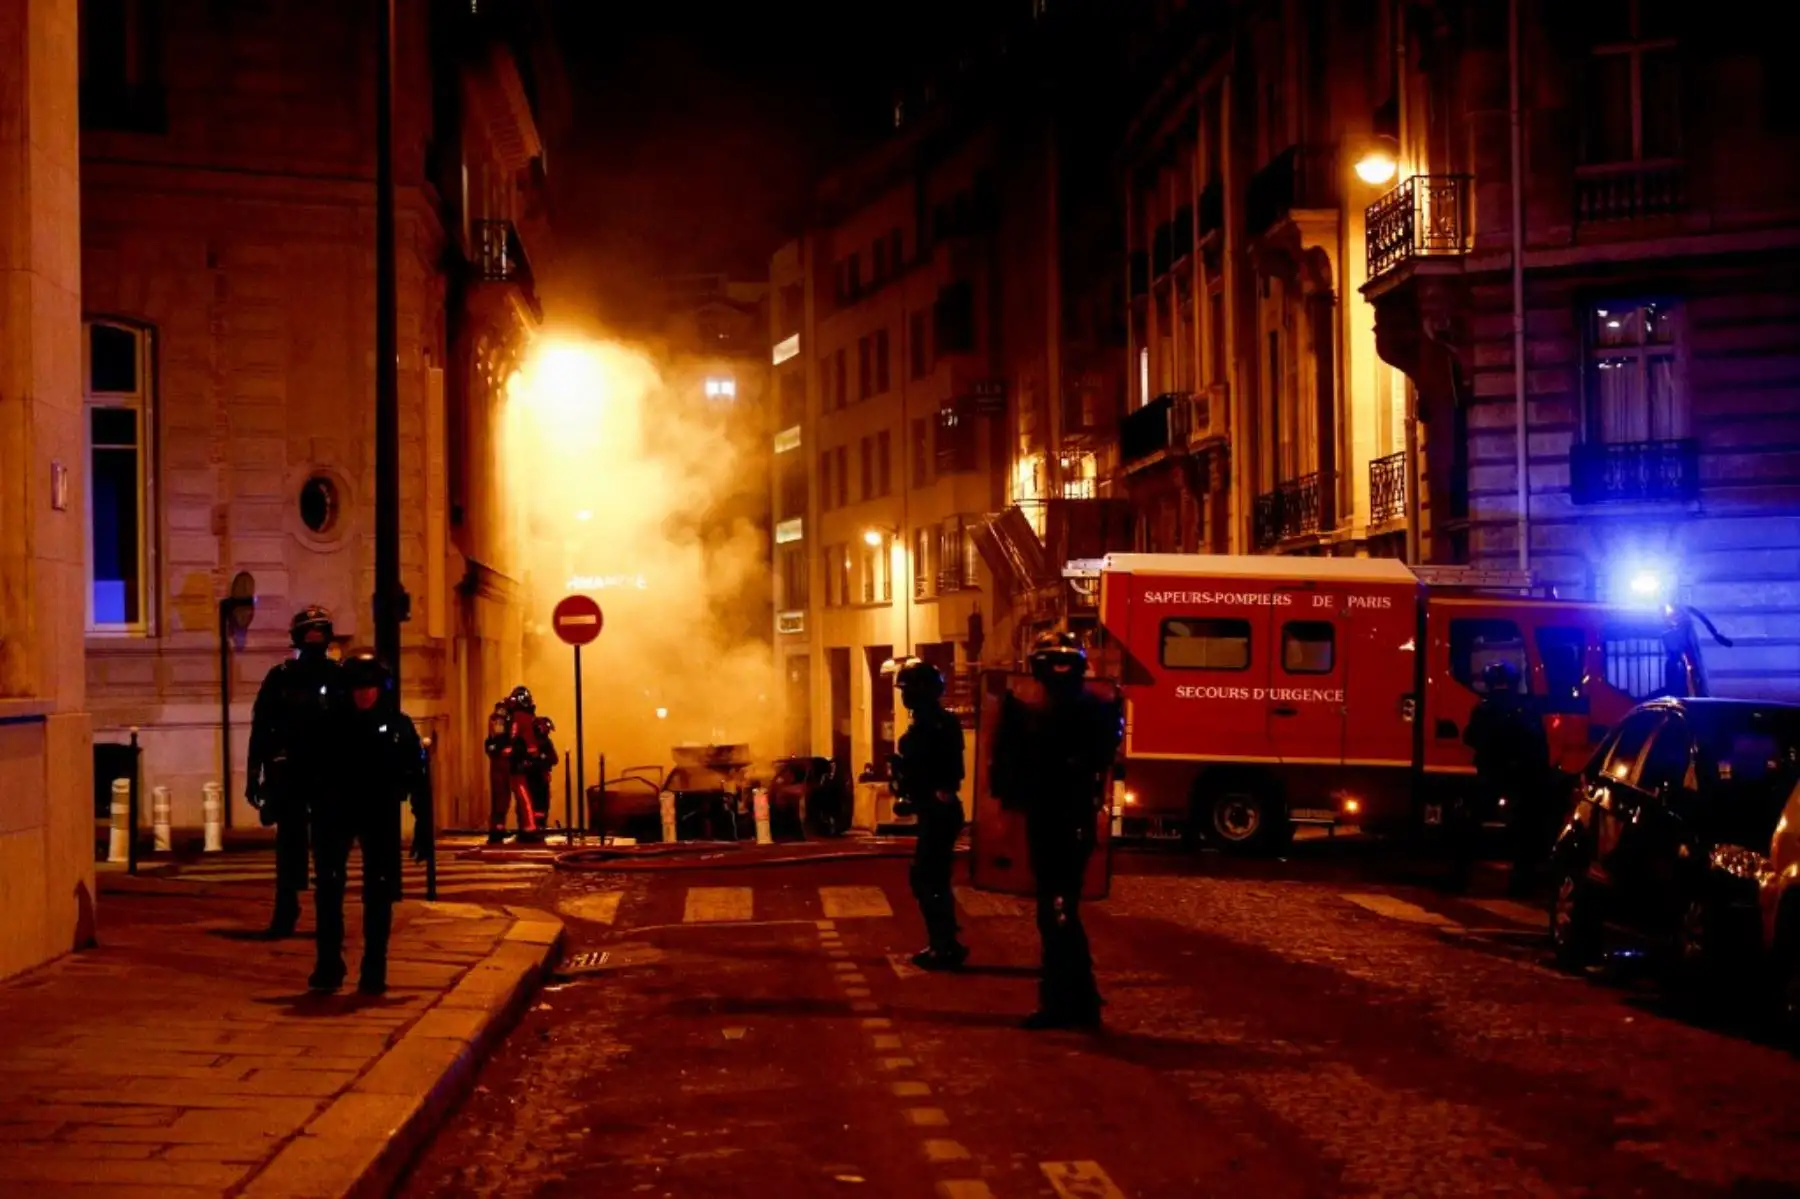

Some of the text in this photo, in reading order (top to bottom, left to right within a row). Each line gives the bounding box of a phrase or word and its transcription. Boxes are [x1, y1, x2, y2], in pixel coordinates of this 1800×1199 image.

[1143, 591, 1392, 608] SAPEURS-POMPIERS DE PARIS
[1175, 686, 1344, 702] SECOURS D'URGENCE
